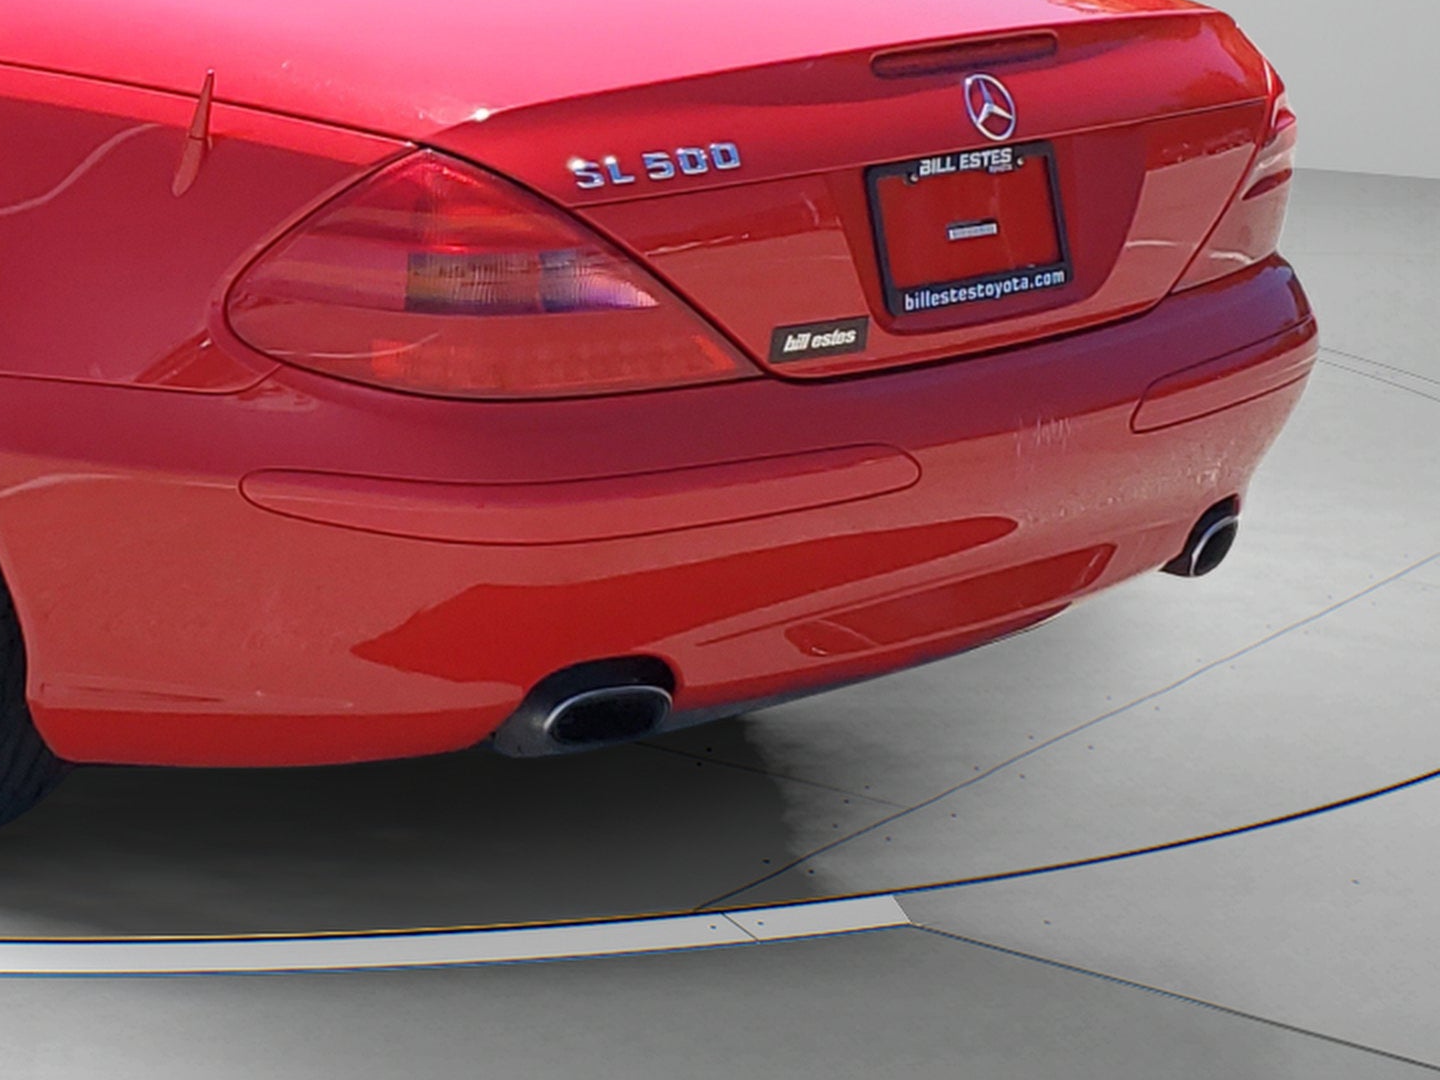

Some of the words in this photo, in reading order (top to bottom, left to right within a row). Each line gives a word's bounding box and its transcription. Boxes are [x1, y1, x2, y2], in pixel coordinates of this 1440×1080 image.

[568, 155, 636, 188] SL
[641, 142, 741, 180] 500
[919, 156, 957, 176] BILL
[959, 147, 1013, 170] ESTES
[904, 270, 1065, 311] billestestoyota.com
[783, 332, 812, 353] bill
[811, 328, 857, 349] estes
